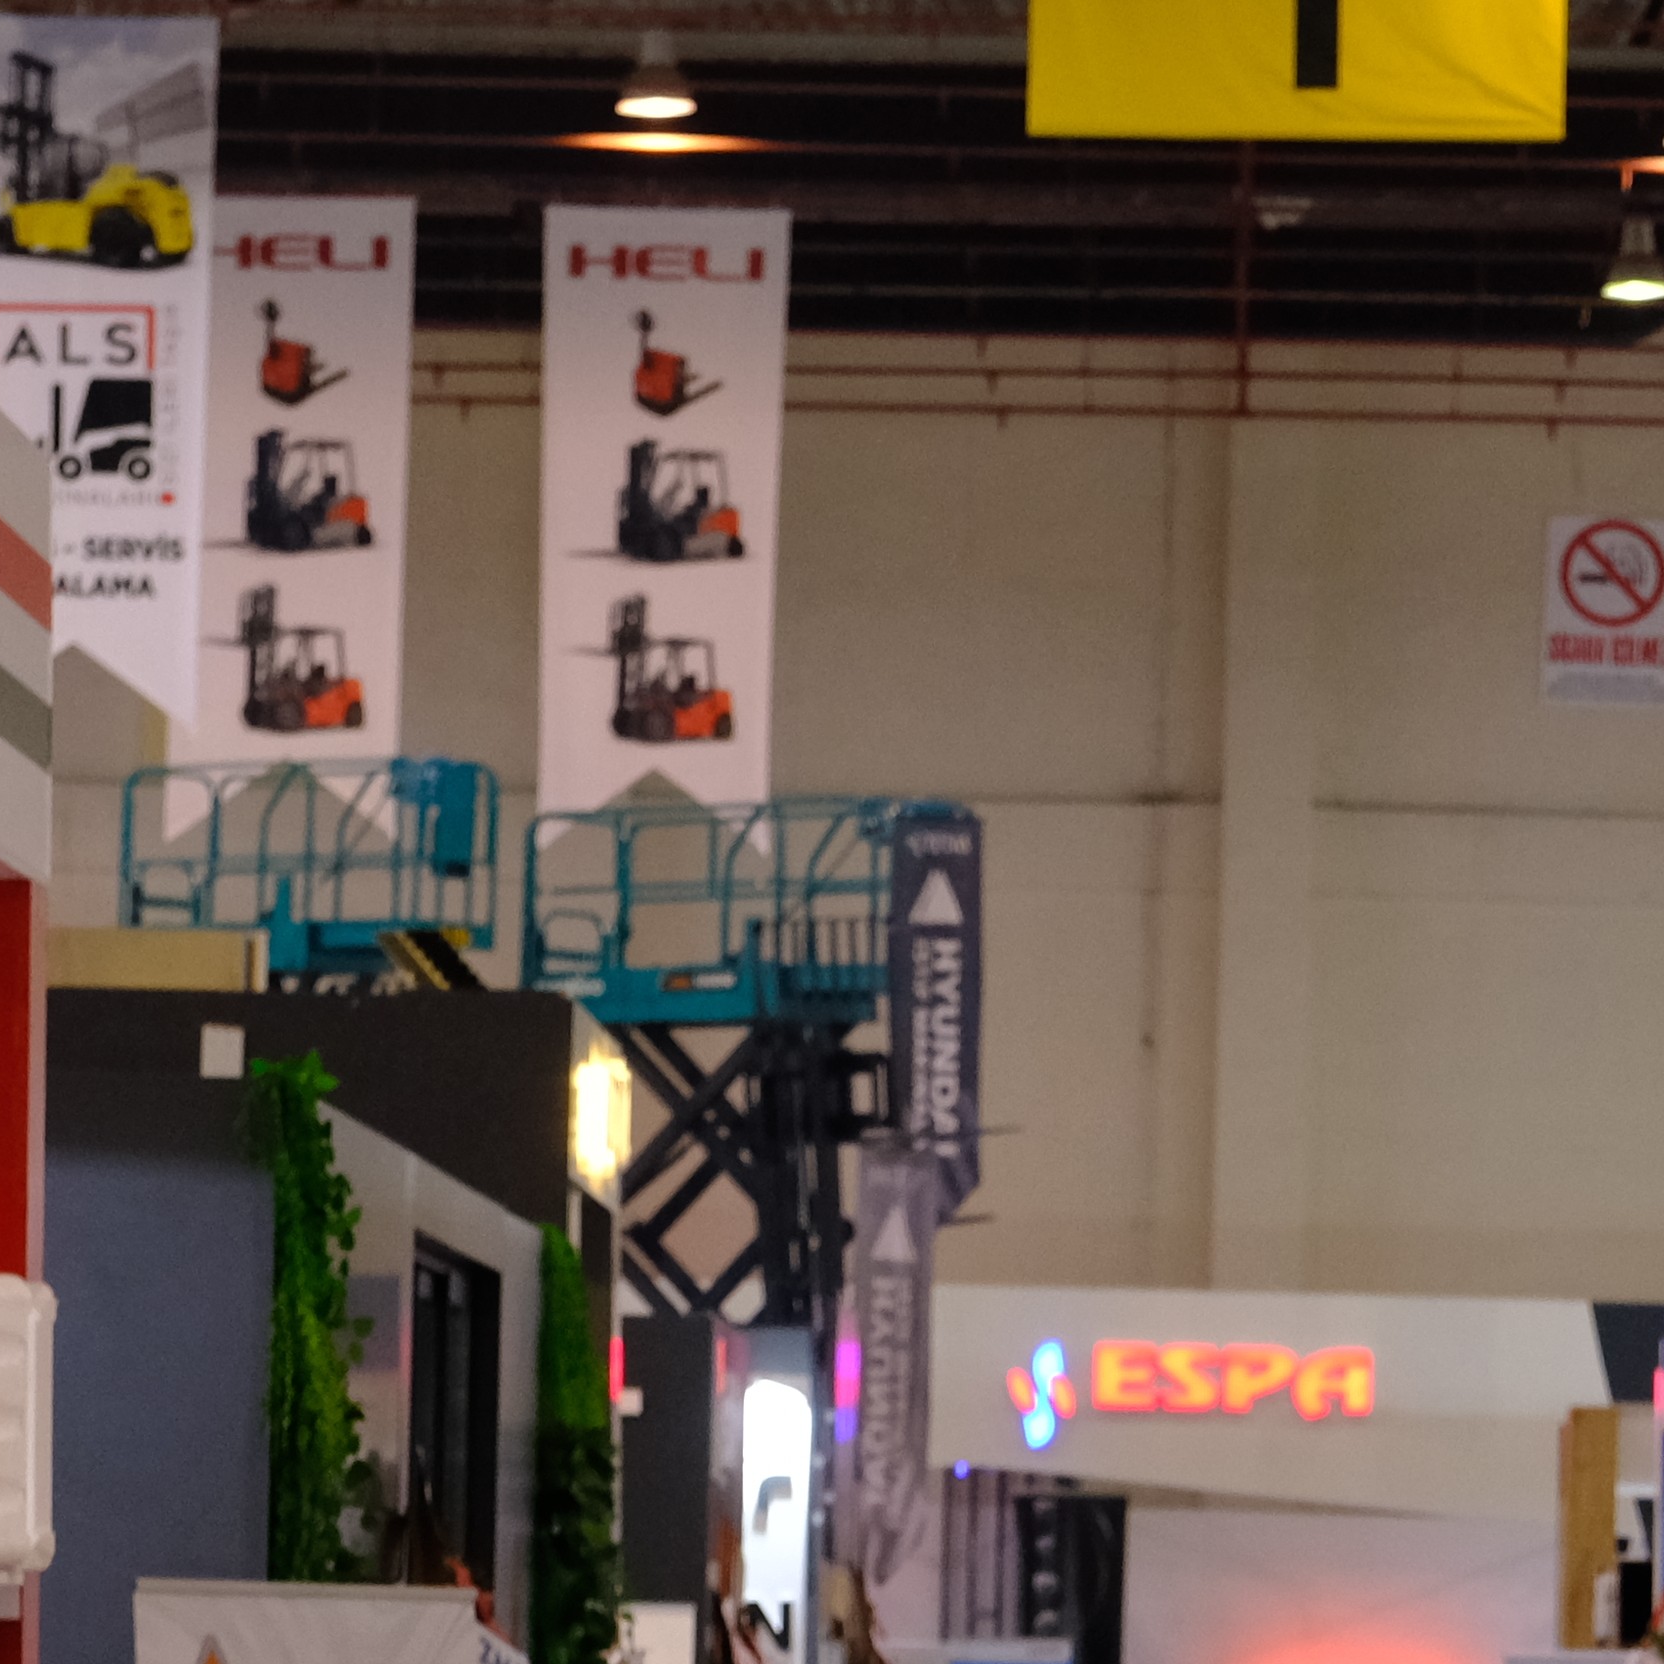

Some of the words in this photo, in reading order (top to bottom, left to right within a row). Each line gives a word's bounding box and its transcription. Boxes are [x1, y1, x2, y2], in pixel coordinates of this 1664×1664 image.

[567, 242, 765, 282] HELI
[4, 322, 138, 368] ALS
[1091, 1339, 1376, 1421] ESPA
